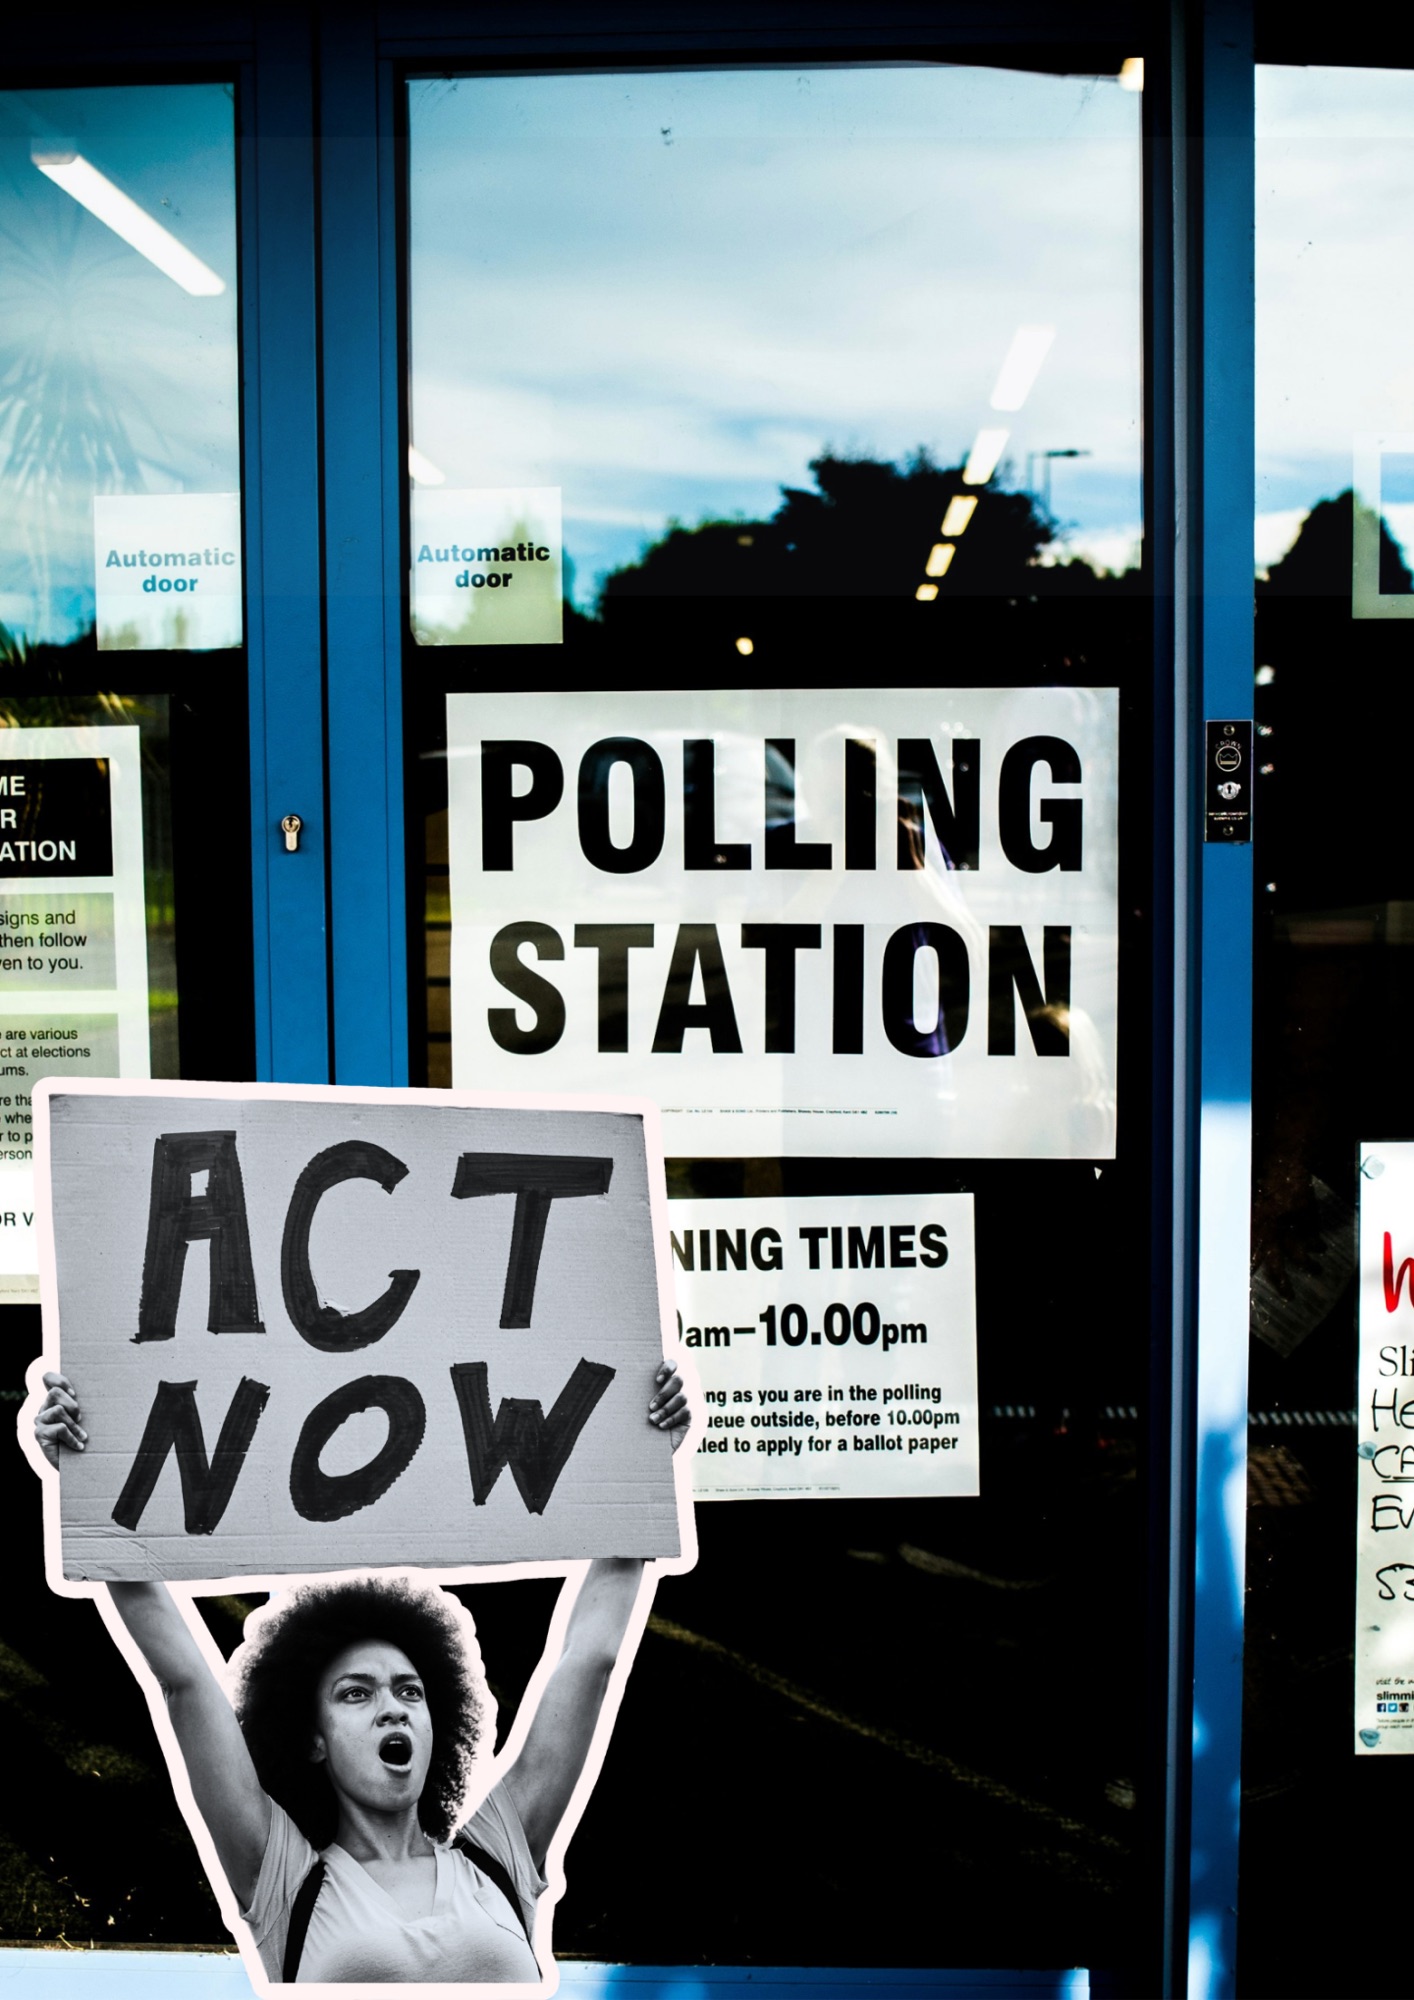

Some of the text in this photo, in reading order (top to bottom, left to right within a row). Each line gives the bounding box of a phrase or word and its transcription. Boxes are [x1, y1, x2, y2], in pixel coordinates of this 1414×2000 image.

[105, 548, 236, 569] Automatic
[418, 541, 551, 563] Automatic
[142, 574, 198, 593] door
[455, 569, 513, 589] door
[481, 733, 1084, 874] POLLING
[45, 910, 76, 925] and
[39, 932, 87, 948] follow
[28, 956, 43, 970] to
[48, 958, 83, 974] you.
[488, 920, 1071, 1058] STATION
[5, 1027, 79, 1040] are various
[16, 1046, 28, 1058] at
[31, 1045, 91, 1058] elections
[8, 1130, 21, 1142] to
[131, 1129, 614, 1352] ACT
[670, 1224, 949, 1271] NING TIMES
[733, 1391, 753, 1403] as
[759, 1391, 788, 1405] you
[794, 1389, 822, 1401] are
[828, 1385, 844, 1401] in
[849, 1385, 877, 1400] the
[883, 1384, 942, 1403] polling
[751, 1412, 820, 1430] outside,
[826, 1411, 881, 1427] before
[887, 1409, 960, 1429] 10.00pm
[112, 1355, 616, 1535] NOW
[735, 1437, 751, 1452] to
[757, 1435, 803, 1455] apply
[808, 1434, 832, 1451] for
[838, 1439, 848, 1450] a
[853, 1434, 903, 1450] ballot
[909, 1436, 958, 1453] paper
